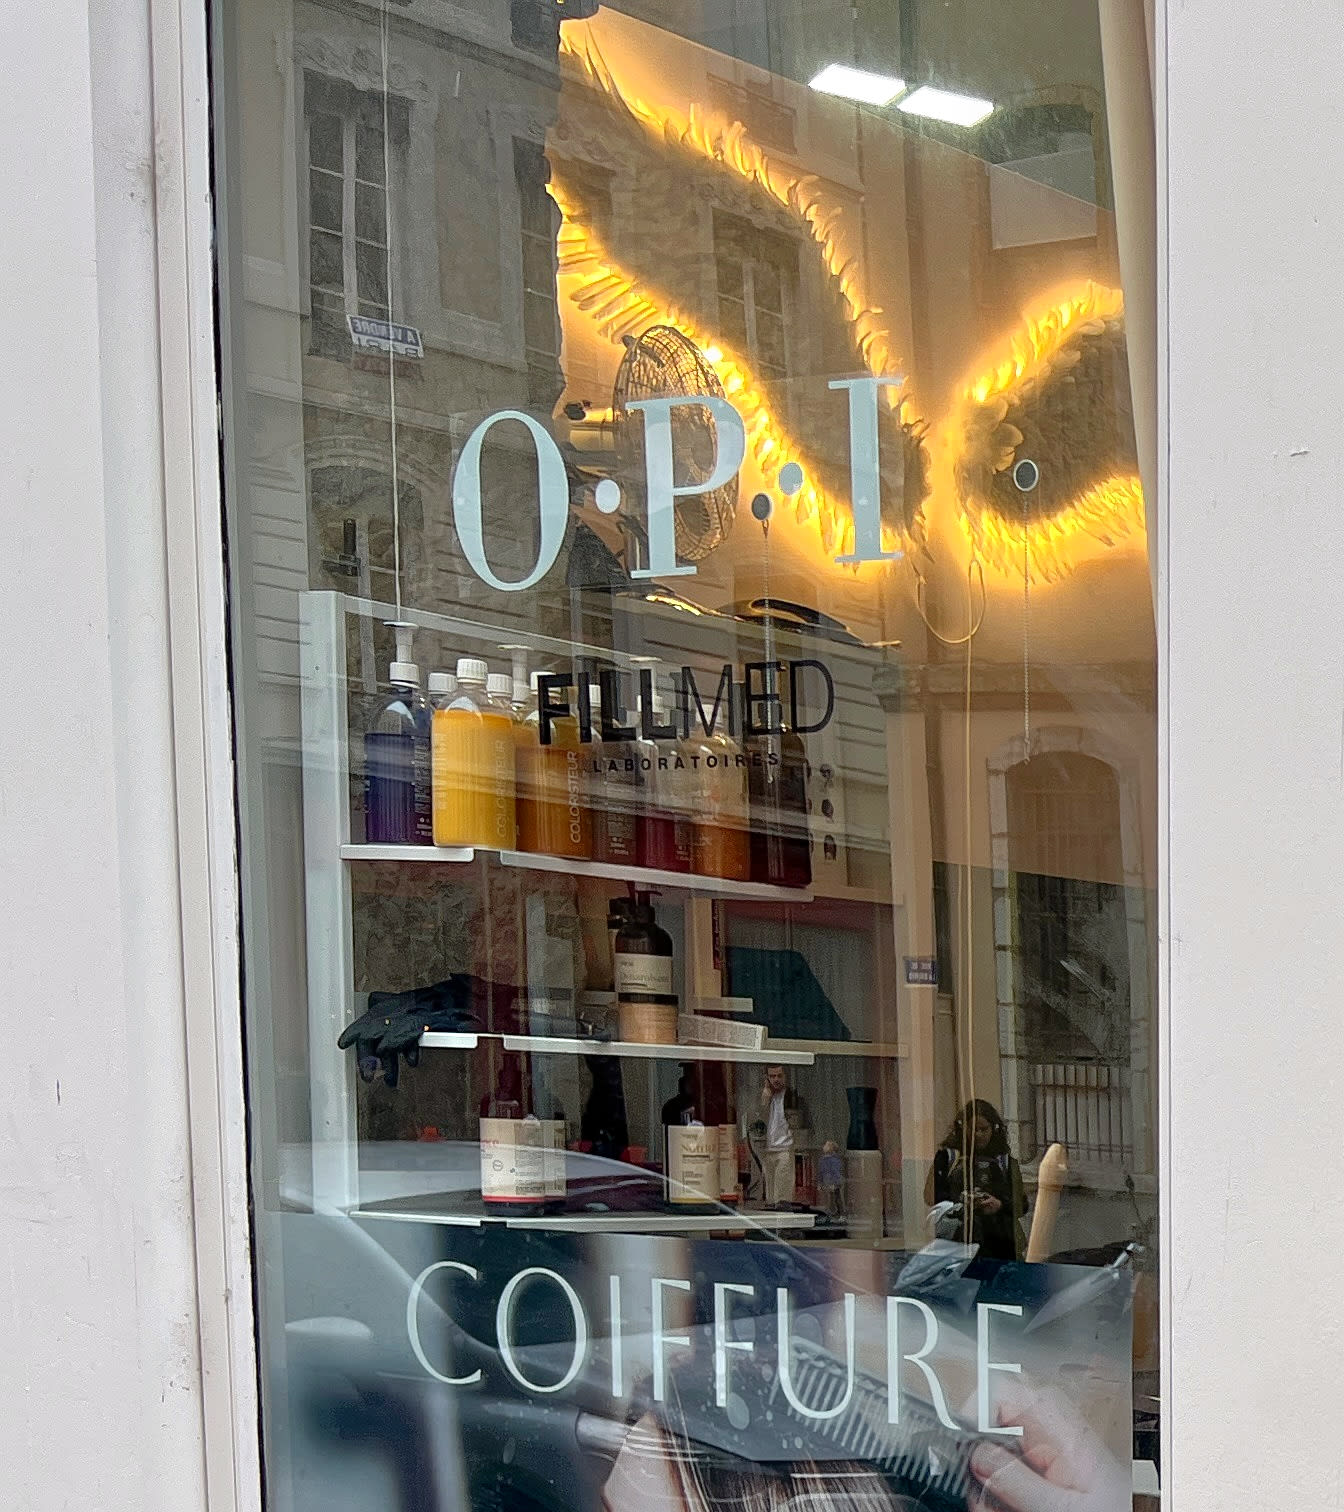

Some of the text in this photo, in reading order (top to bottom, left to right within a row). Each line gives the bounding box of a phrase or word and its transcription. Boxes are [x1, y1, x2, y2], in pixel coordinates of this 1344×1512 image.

[537, 659, 835, 745] FILLMED
[593, 751, 780, 773] LABORATOIRES
[405, 1260, 1025, 1436] COIFFURE
